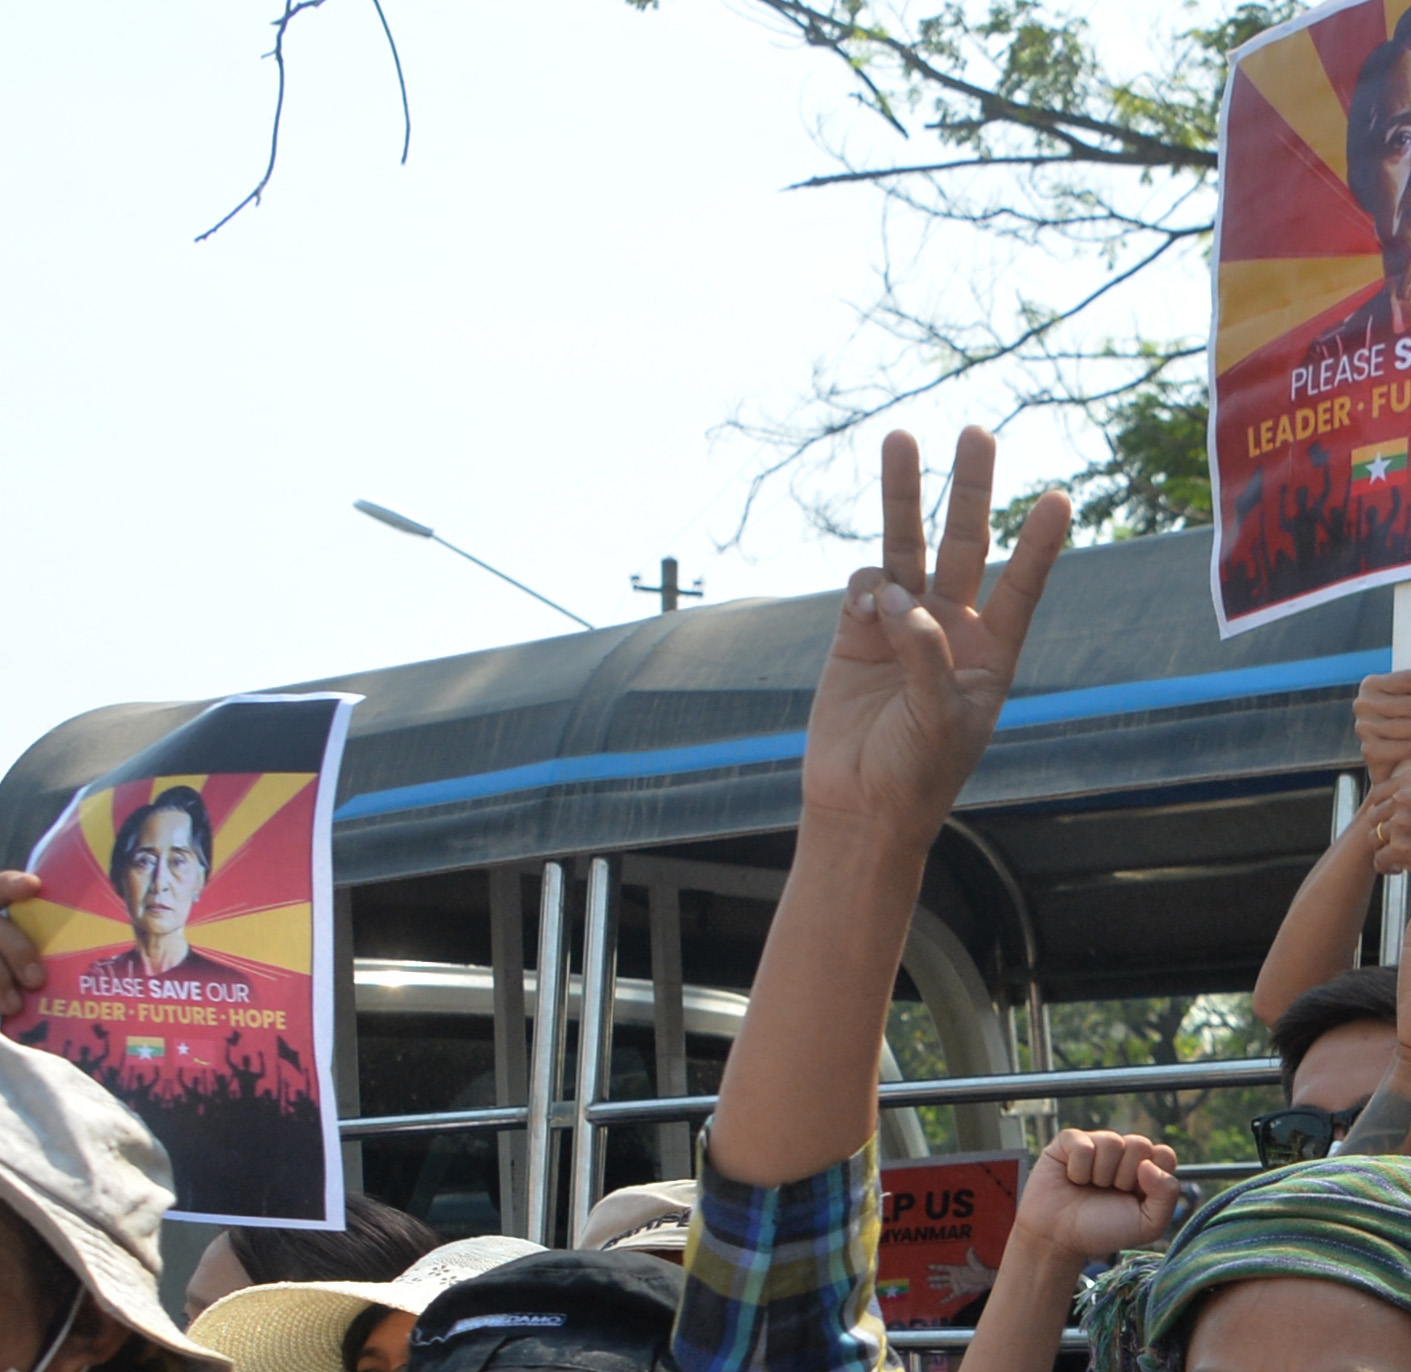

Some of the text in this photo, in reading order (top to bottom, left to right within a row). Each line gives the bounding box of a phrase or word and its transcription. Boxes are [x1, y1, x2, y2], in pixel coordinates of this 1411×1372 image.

[1291, 343, 1385, 400] PLEASE
[1248, 400, 1350, 458] LEADER
[79, 976, 250, 1003] PLEASE SAVE OUR
[39, 998, 286, 1030] LEADER FUTURE HOPE
[925, 1188, 975, 1221] US
